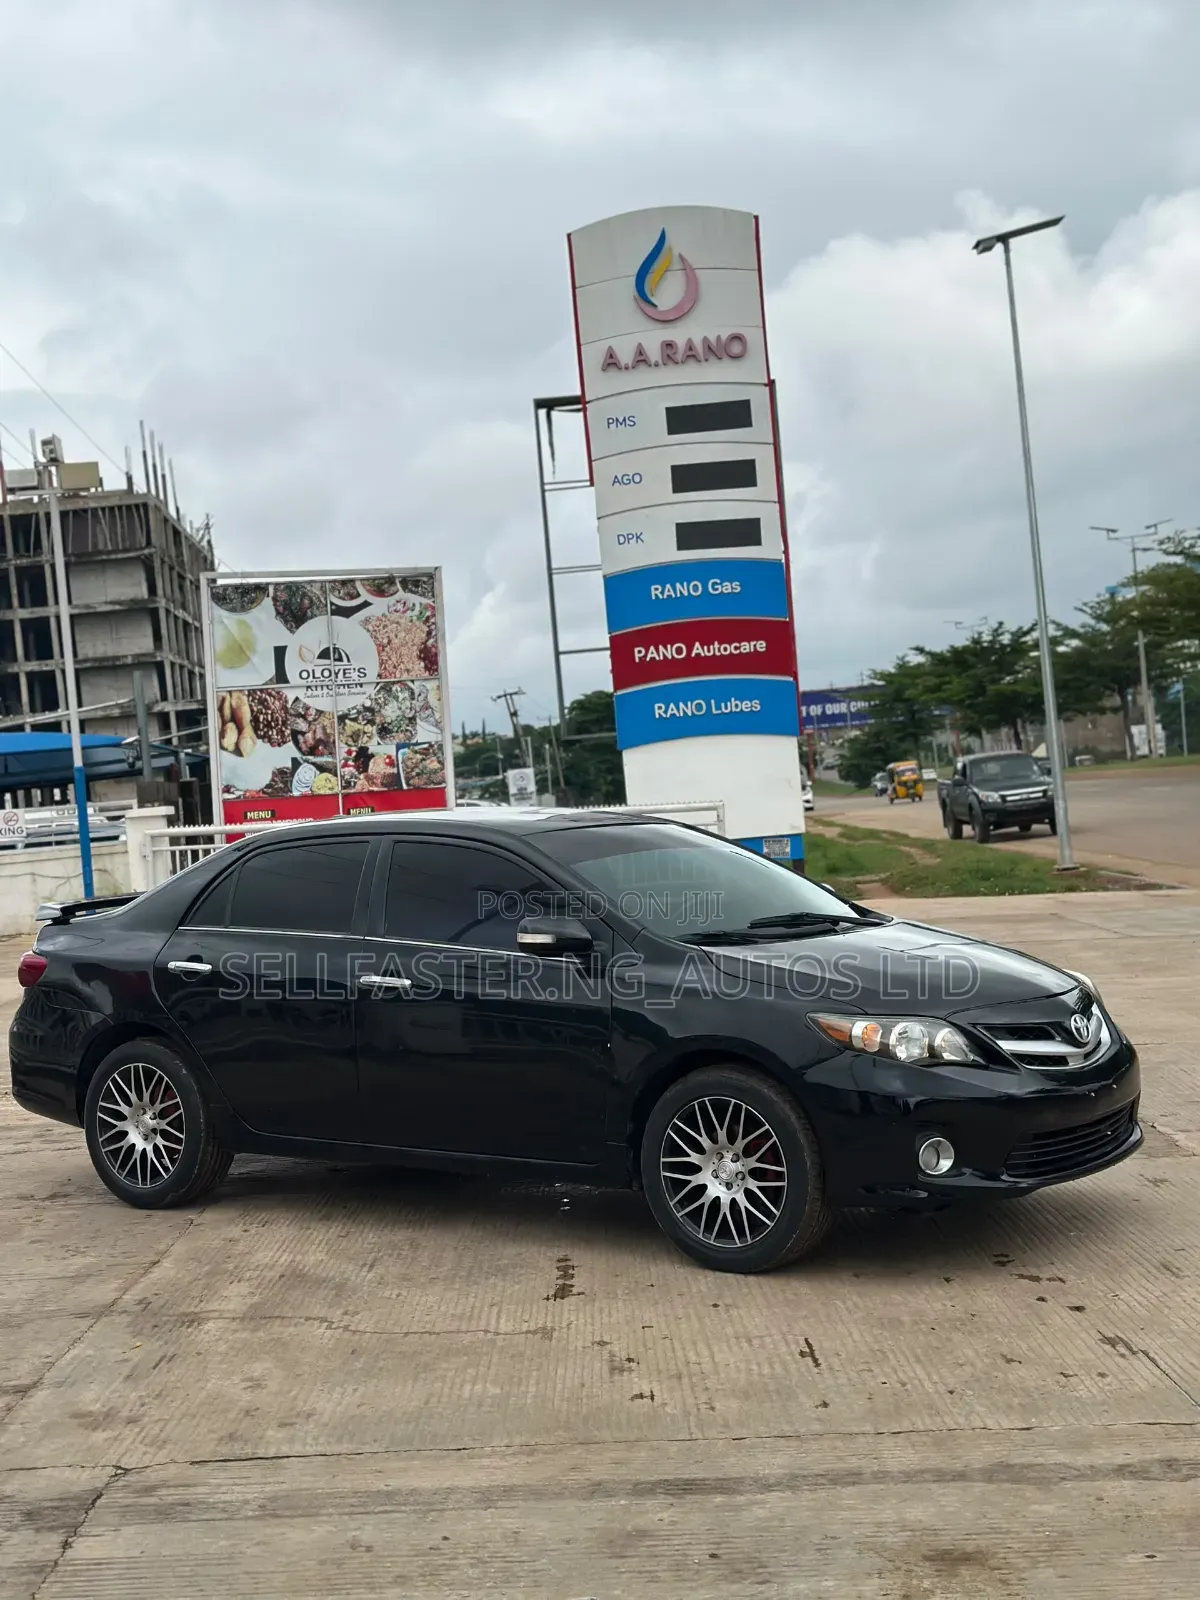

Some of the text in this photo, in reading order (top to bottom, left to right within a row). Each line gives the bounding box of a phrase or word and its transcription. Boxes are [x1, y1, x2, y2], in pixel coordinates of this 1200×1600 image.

[601, 332, 748, 372] A.A.RANO
[606, 415, 637, 429] PMS
[612, 472, 643, 486] AGO
[617, 531, 645, 545] DPK
[651, 578, 742, 600] RANO Gas
[690, 639, 767, 658] Autocare
[298, 667, 368, 681] OLOYE'S
[654, 697, 761, 718] RANO Lubes
[809, 704, 823, 717] OF
[825, 702, 849, 715] OUR
[247, 811, 272, 820] MENU
